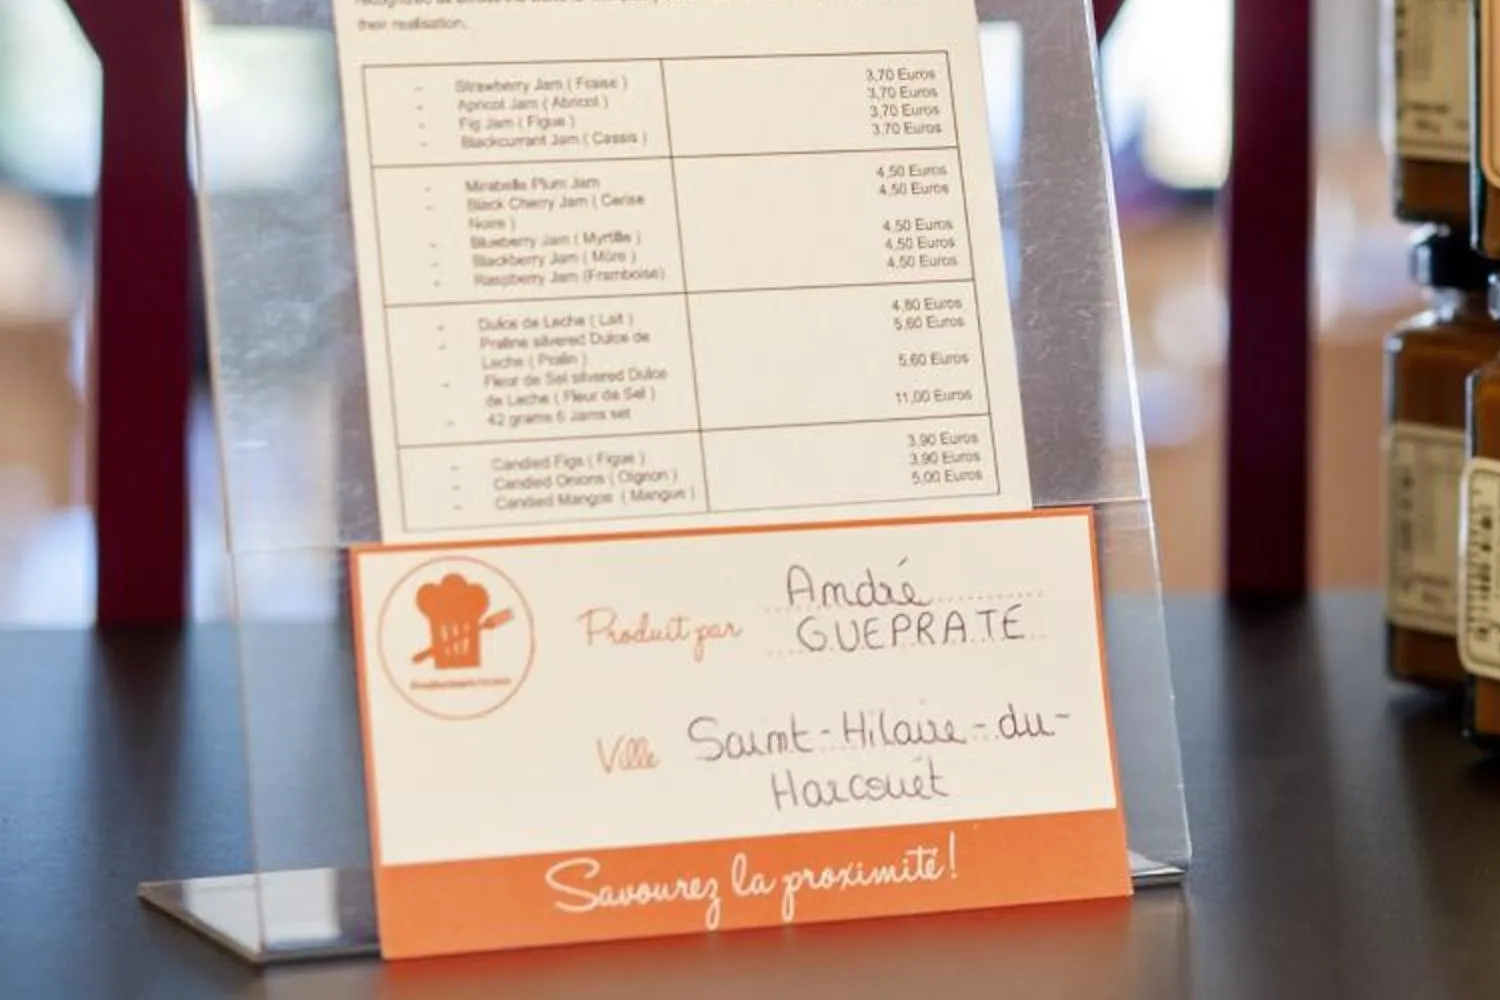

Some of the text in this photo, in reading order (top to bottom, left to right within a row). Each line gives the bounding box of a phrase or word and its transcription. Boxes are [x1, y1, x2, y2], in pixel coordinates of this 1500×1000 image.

[897, 66, 937, 82] Euros
[455, 76, 618, 94] Strawberry Jam Fraise
[898, 85, 939, 100] Euros
[457, 98, 506, 112] Apricot
[510, 98, 539, 111] Jam
[900, 102, 941, 118] Euros
[458, 114, 566, 133] Fig Jam Figue
[902, 121, 943, 135] Euros
[460, 131, 639, 150] Blackcurrant Jam Cassis
[907, 163, 948, 178] Euros
[910, 181, 950, 196] Euros
[914, 217, 954, 232] Euros
[916, 235, 956, 250] Euros
[918, 253, 959, 269] Euros
[923, 296, 963, 311] Euros
[521, 317, 540, 330] de
[925, 314, 966, 330] Euros
[929, 351, 970, 366] Euros
[932, 388, 973, 403] Euros
[938, 430, 980, 446] Euros
[941, 450, 982, 465] Euros
[943, 468, 984, 484] Euros
[786, 558, 931, 607] André
[577, 607, 743, 661] Produit par
[596, 737, 660, 774] Ville
[545, 857, 721, 930] Savourez
[731, 852, 777, 897] la
